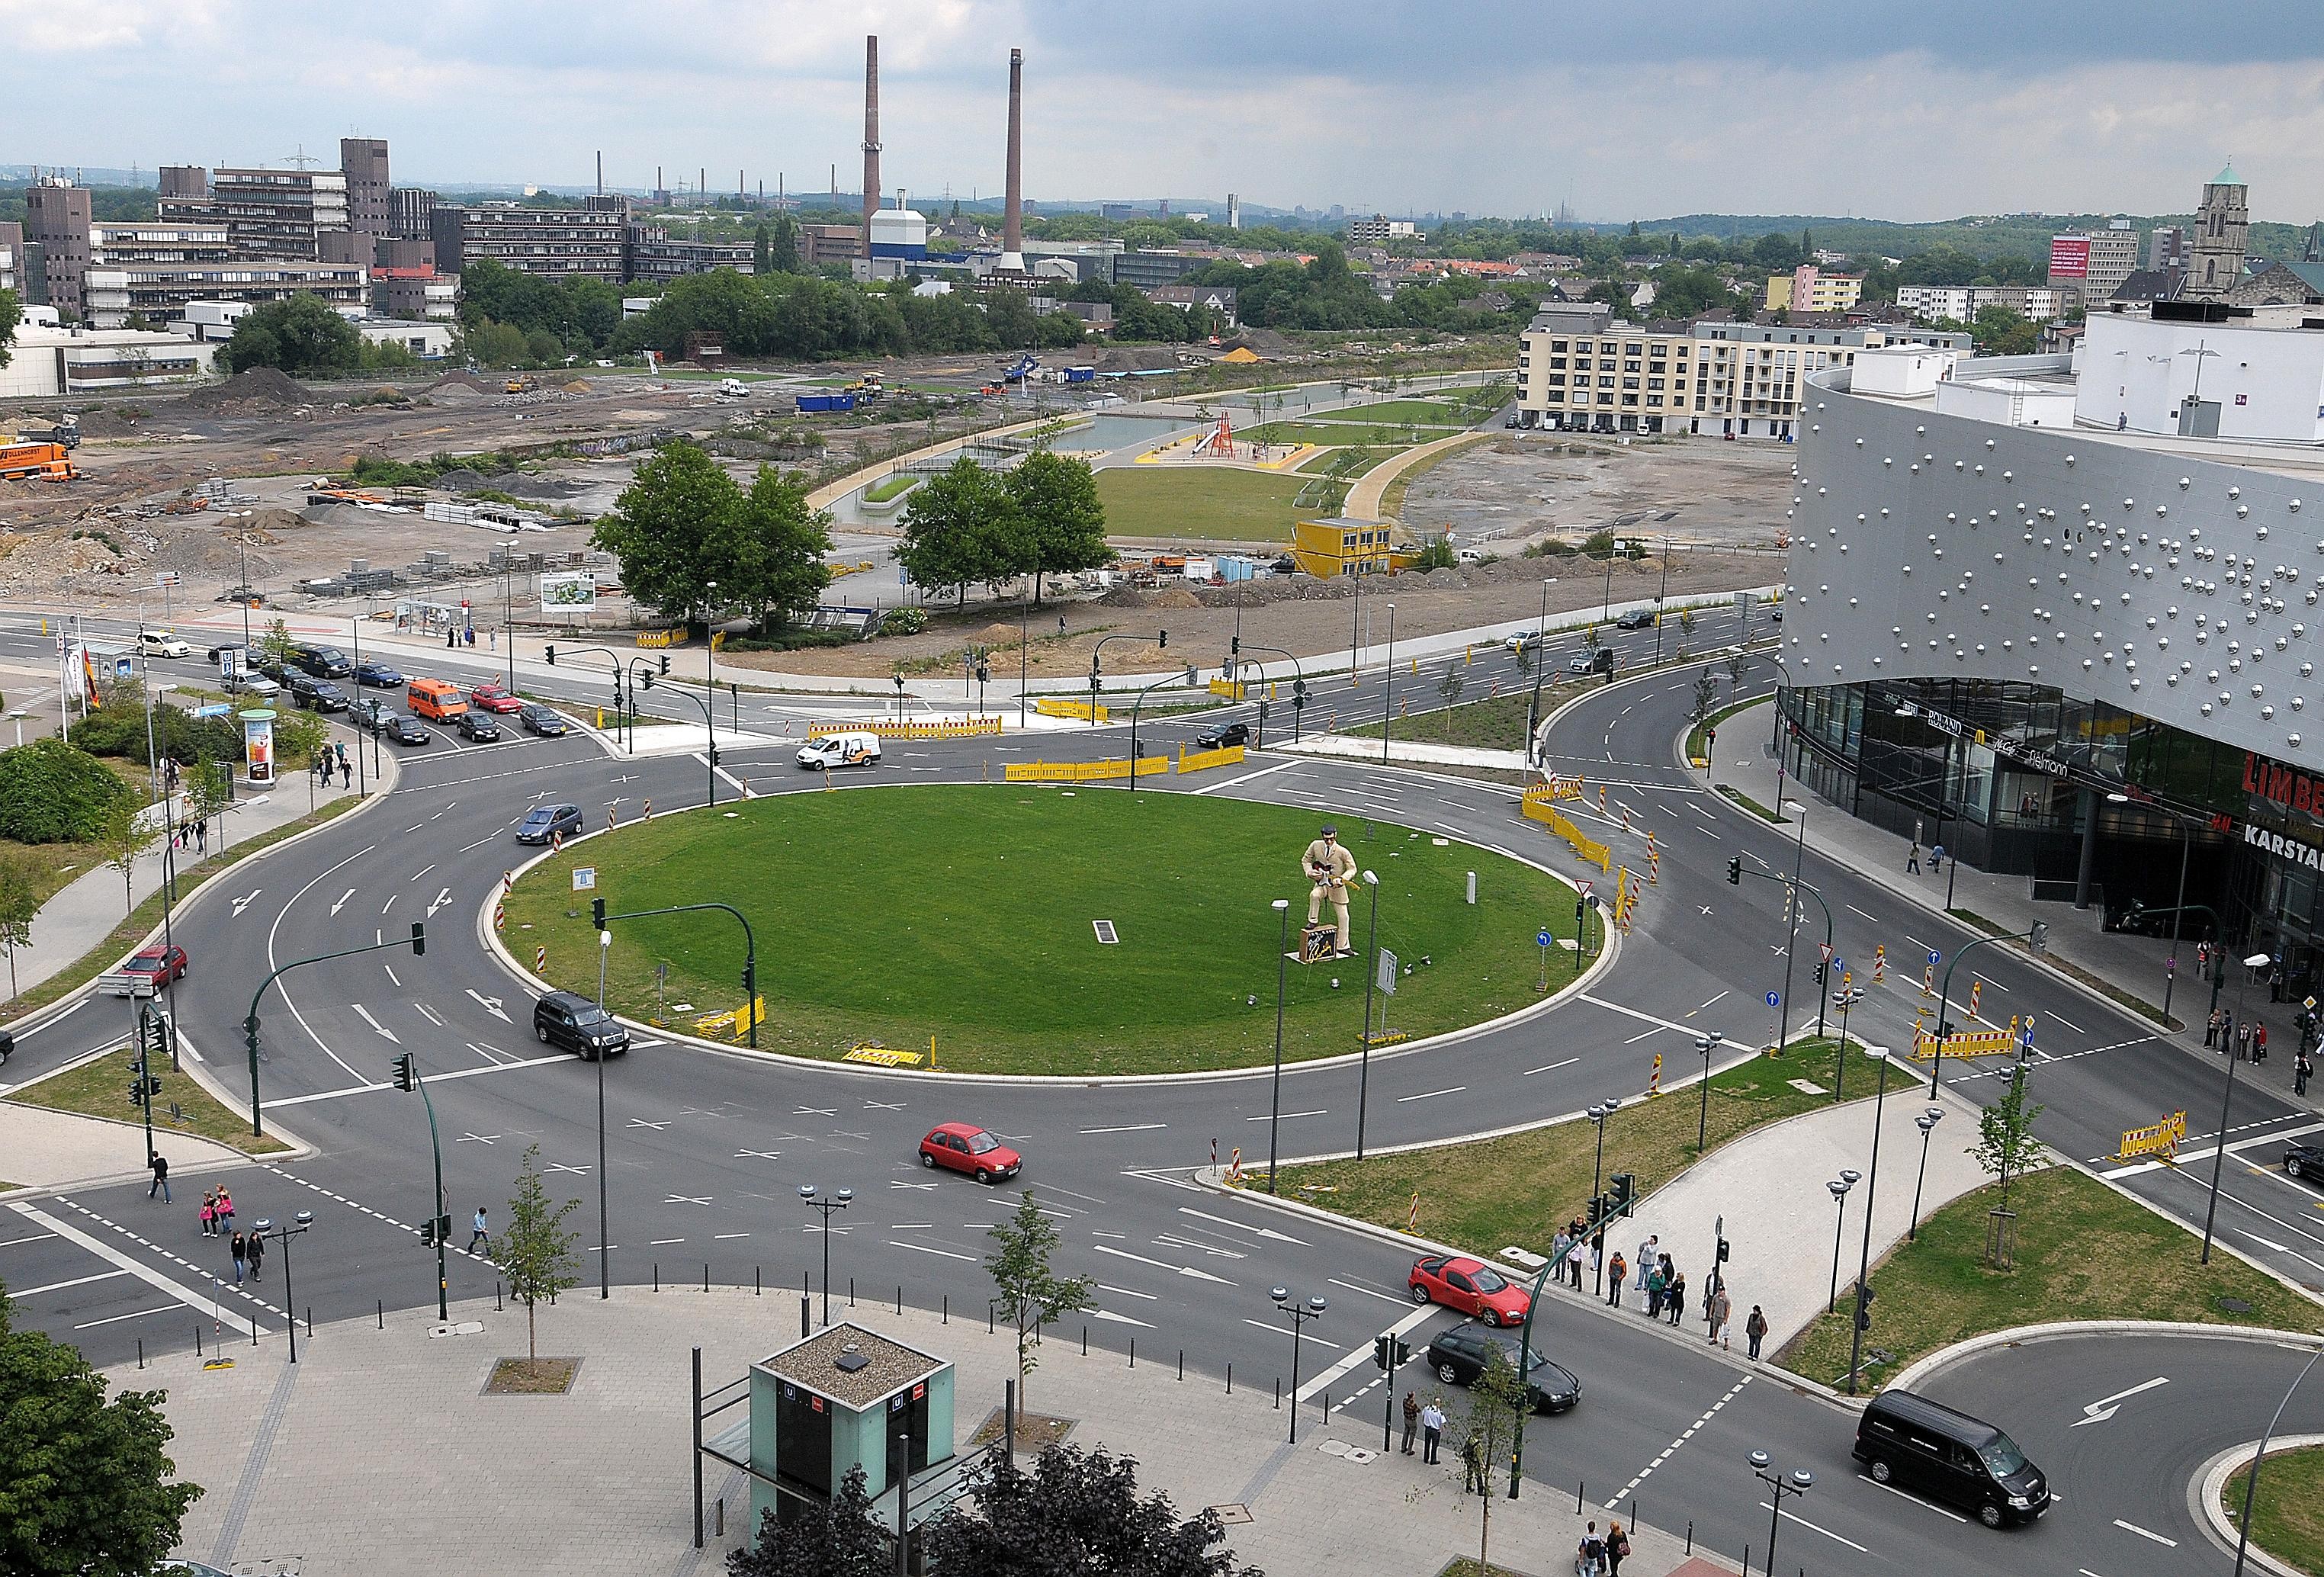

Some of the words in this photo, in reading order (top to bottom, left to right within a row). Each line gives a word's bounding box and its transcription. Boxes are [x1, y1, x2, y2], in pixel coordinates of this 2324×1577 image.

[1928, 710, 1962, 735] ROLAND
[2245, 824, 2324, 872] KARSTA
[787, 1387, 793, 1396] U
[894, 1397, 900, 1407] U
